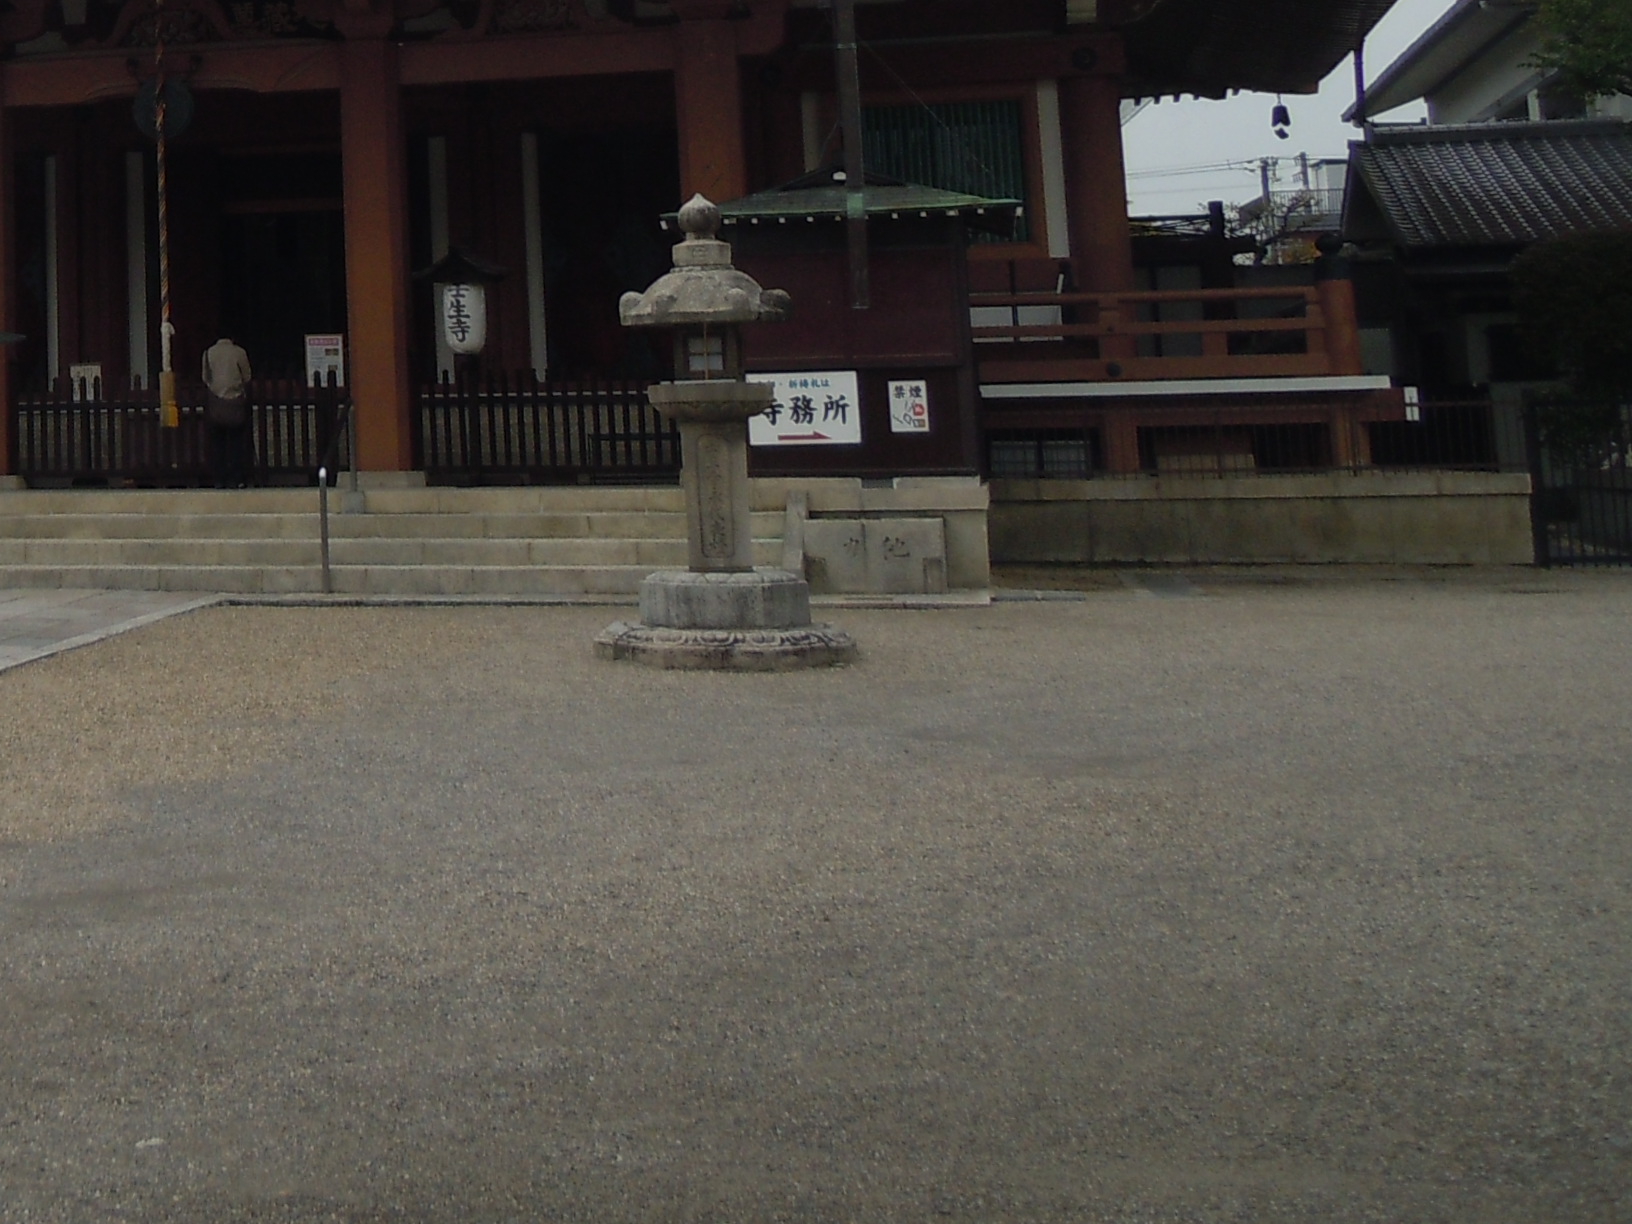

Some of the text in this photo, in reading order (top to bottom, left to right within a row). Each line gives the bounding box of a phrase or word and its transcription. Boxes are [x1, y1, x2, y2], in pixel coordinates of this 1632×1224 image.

[447, 283, 471, 343] 壬生寺
[894, 385, 923, 399] 禁煙
